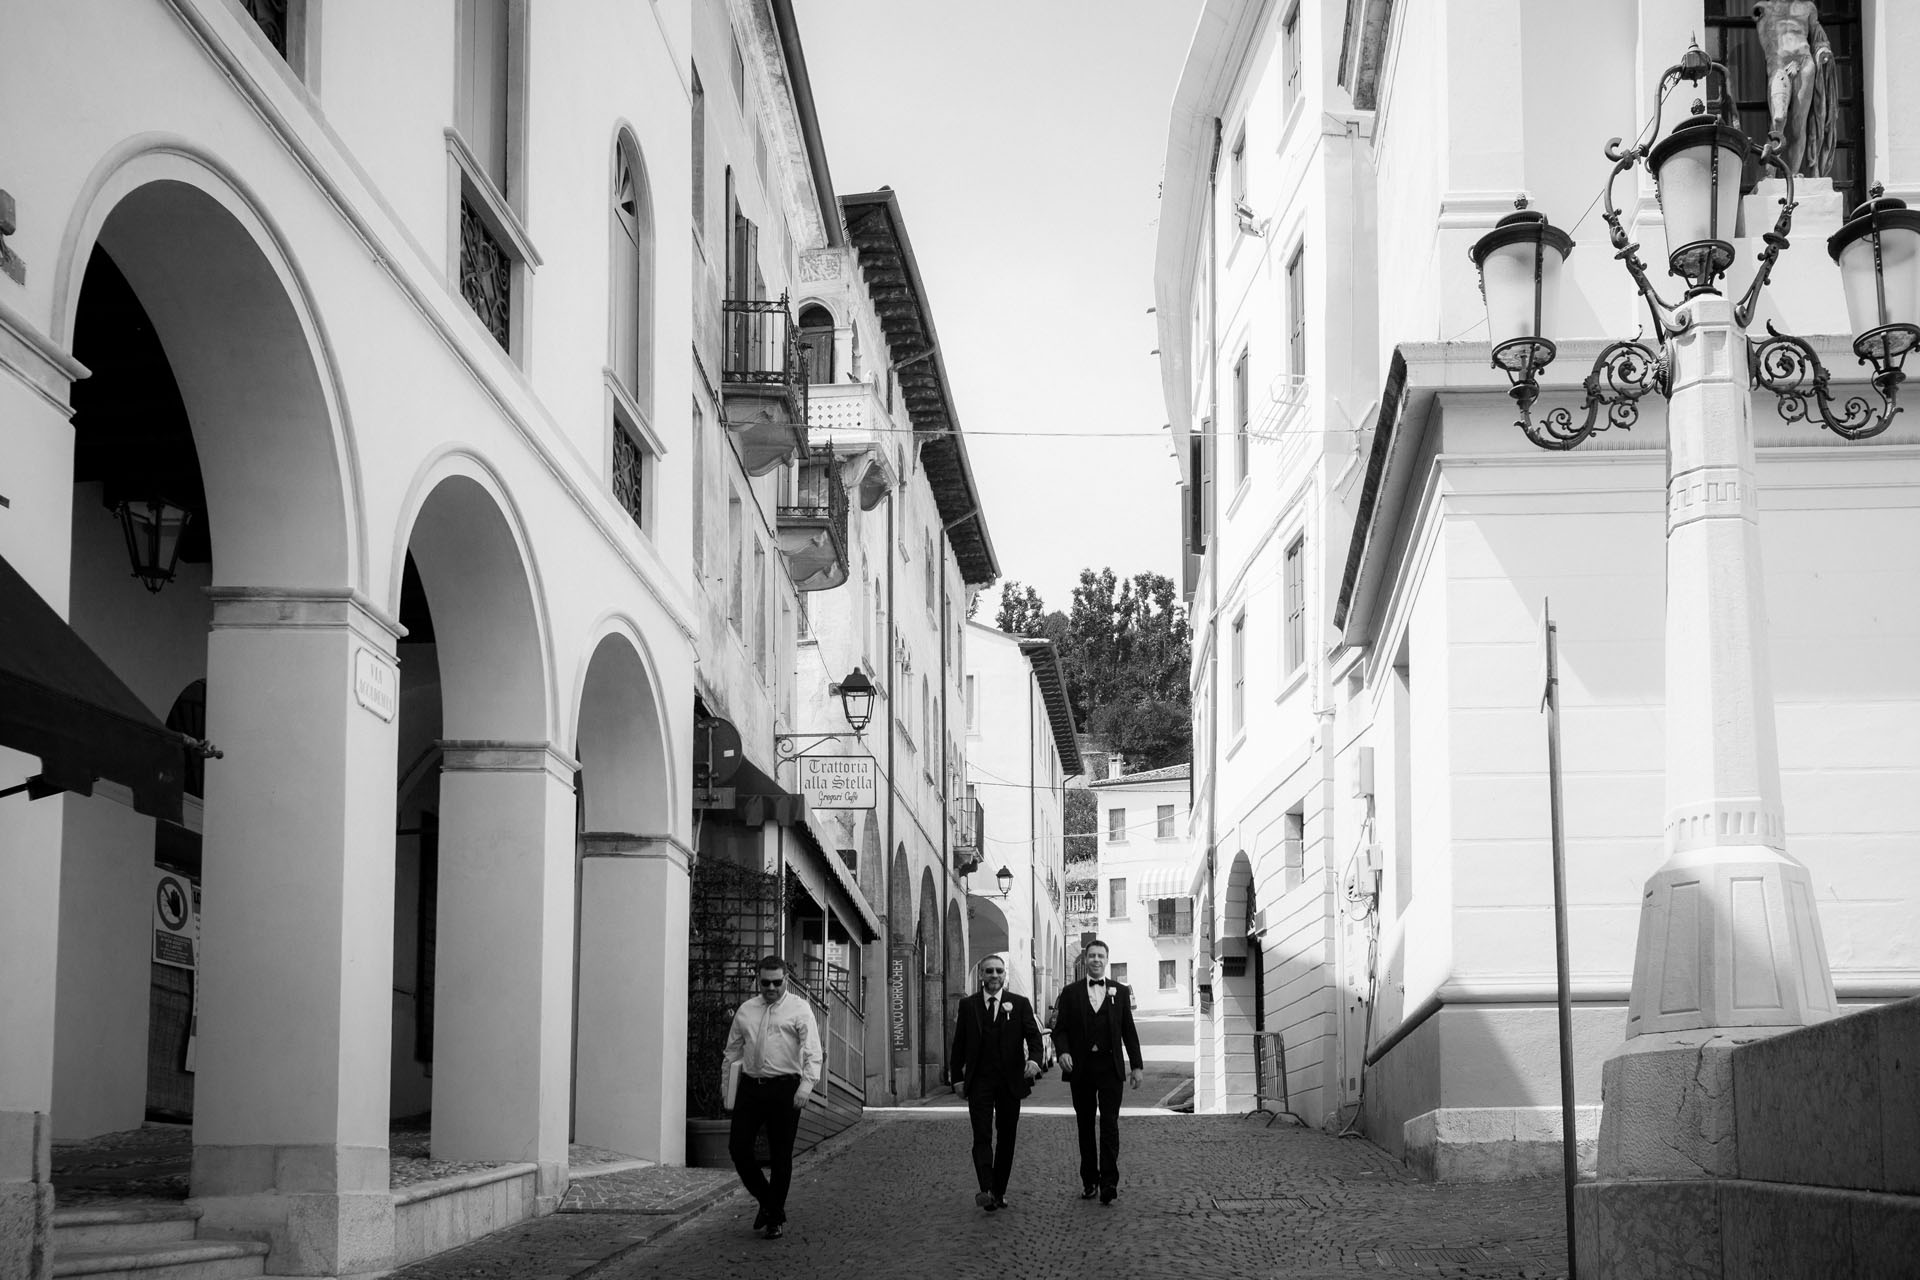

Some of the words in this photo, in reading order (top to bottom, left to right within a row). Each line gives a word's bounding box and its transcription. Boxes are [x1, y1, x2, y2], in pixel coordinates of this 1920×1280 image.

[370, 663, 382, 685] VIA
[809, 759, 868, 774] Trattoria
[804, 776, 827, 790] alla
[832, 775, 872, 790] Stella
[893, 959, 903, 1011] CORROCHER
[893, 1012, 904, 1045] FRANCO
